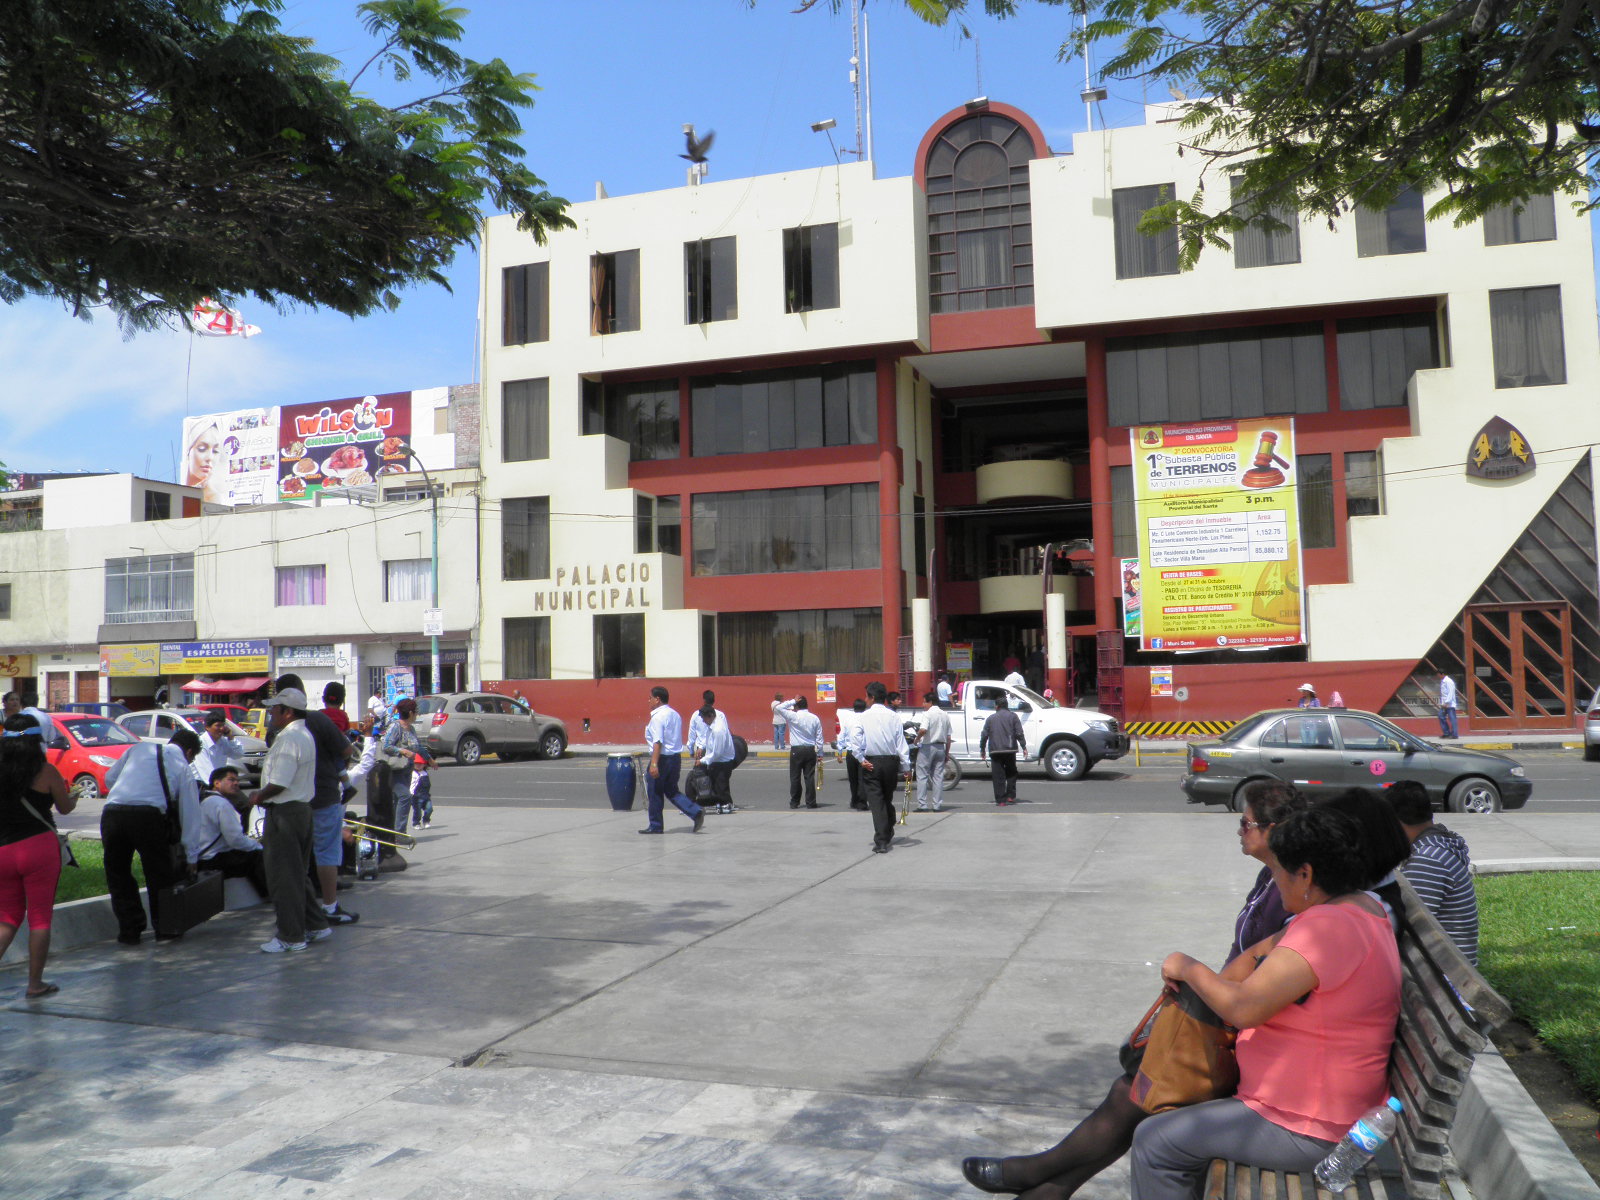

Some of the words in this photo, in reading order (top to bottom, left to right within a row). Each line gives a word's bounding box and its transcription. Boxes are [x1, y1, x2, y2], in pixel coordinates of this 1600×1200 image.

[1182, 446, 1234, 454] CONVOCATORIA
[1166, 456, 1202, 464] Subasta
[1204, 453, 1236, 462] Pública
[1166, 462, 1236, 476] TERRENOS
[1150, 476, 1236, 488] MUNICIPALES
[1254, 495, 1274, 504] p.m.
[556, 562, 650, 586] PALACIO
[534, 587, 650, 611] MUNICIPAL
[187, 648, 265, 656] ESPECIALISTAS
